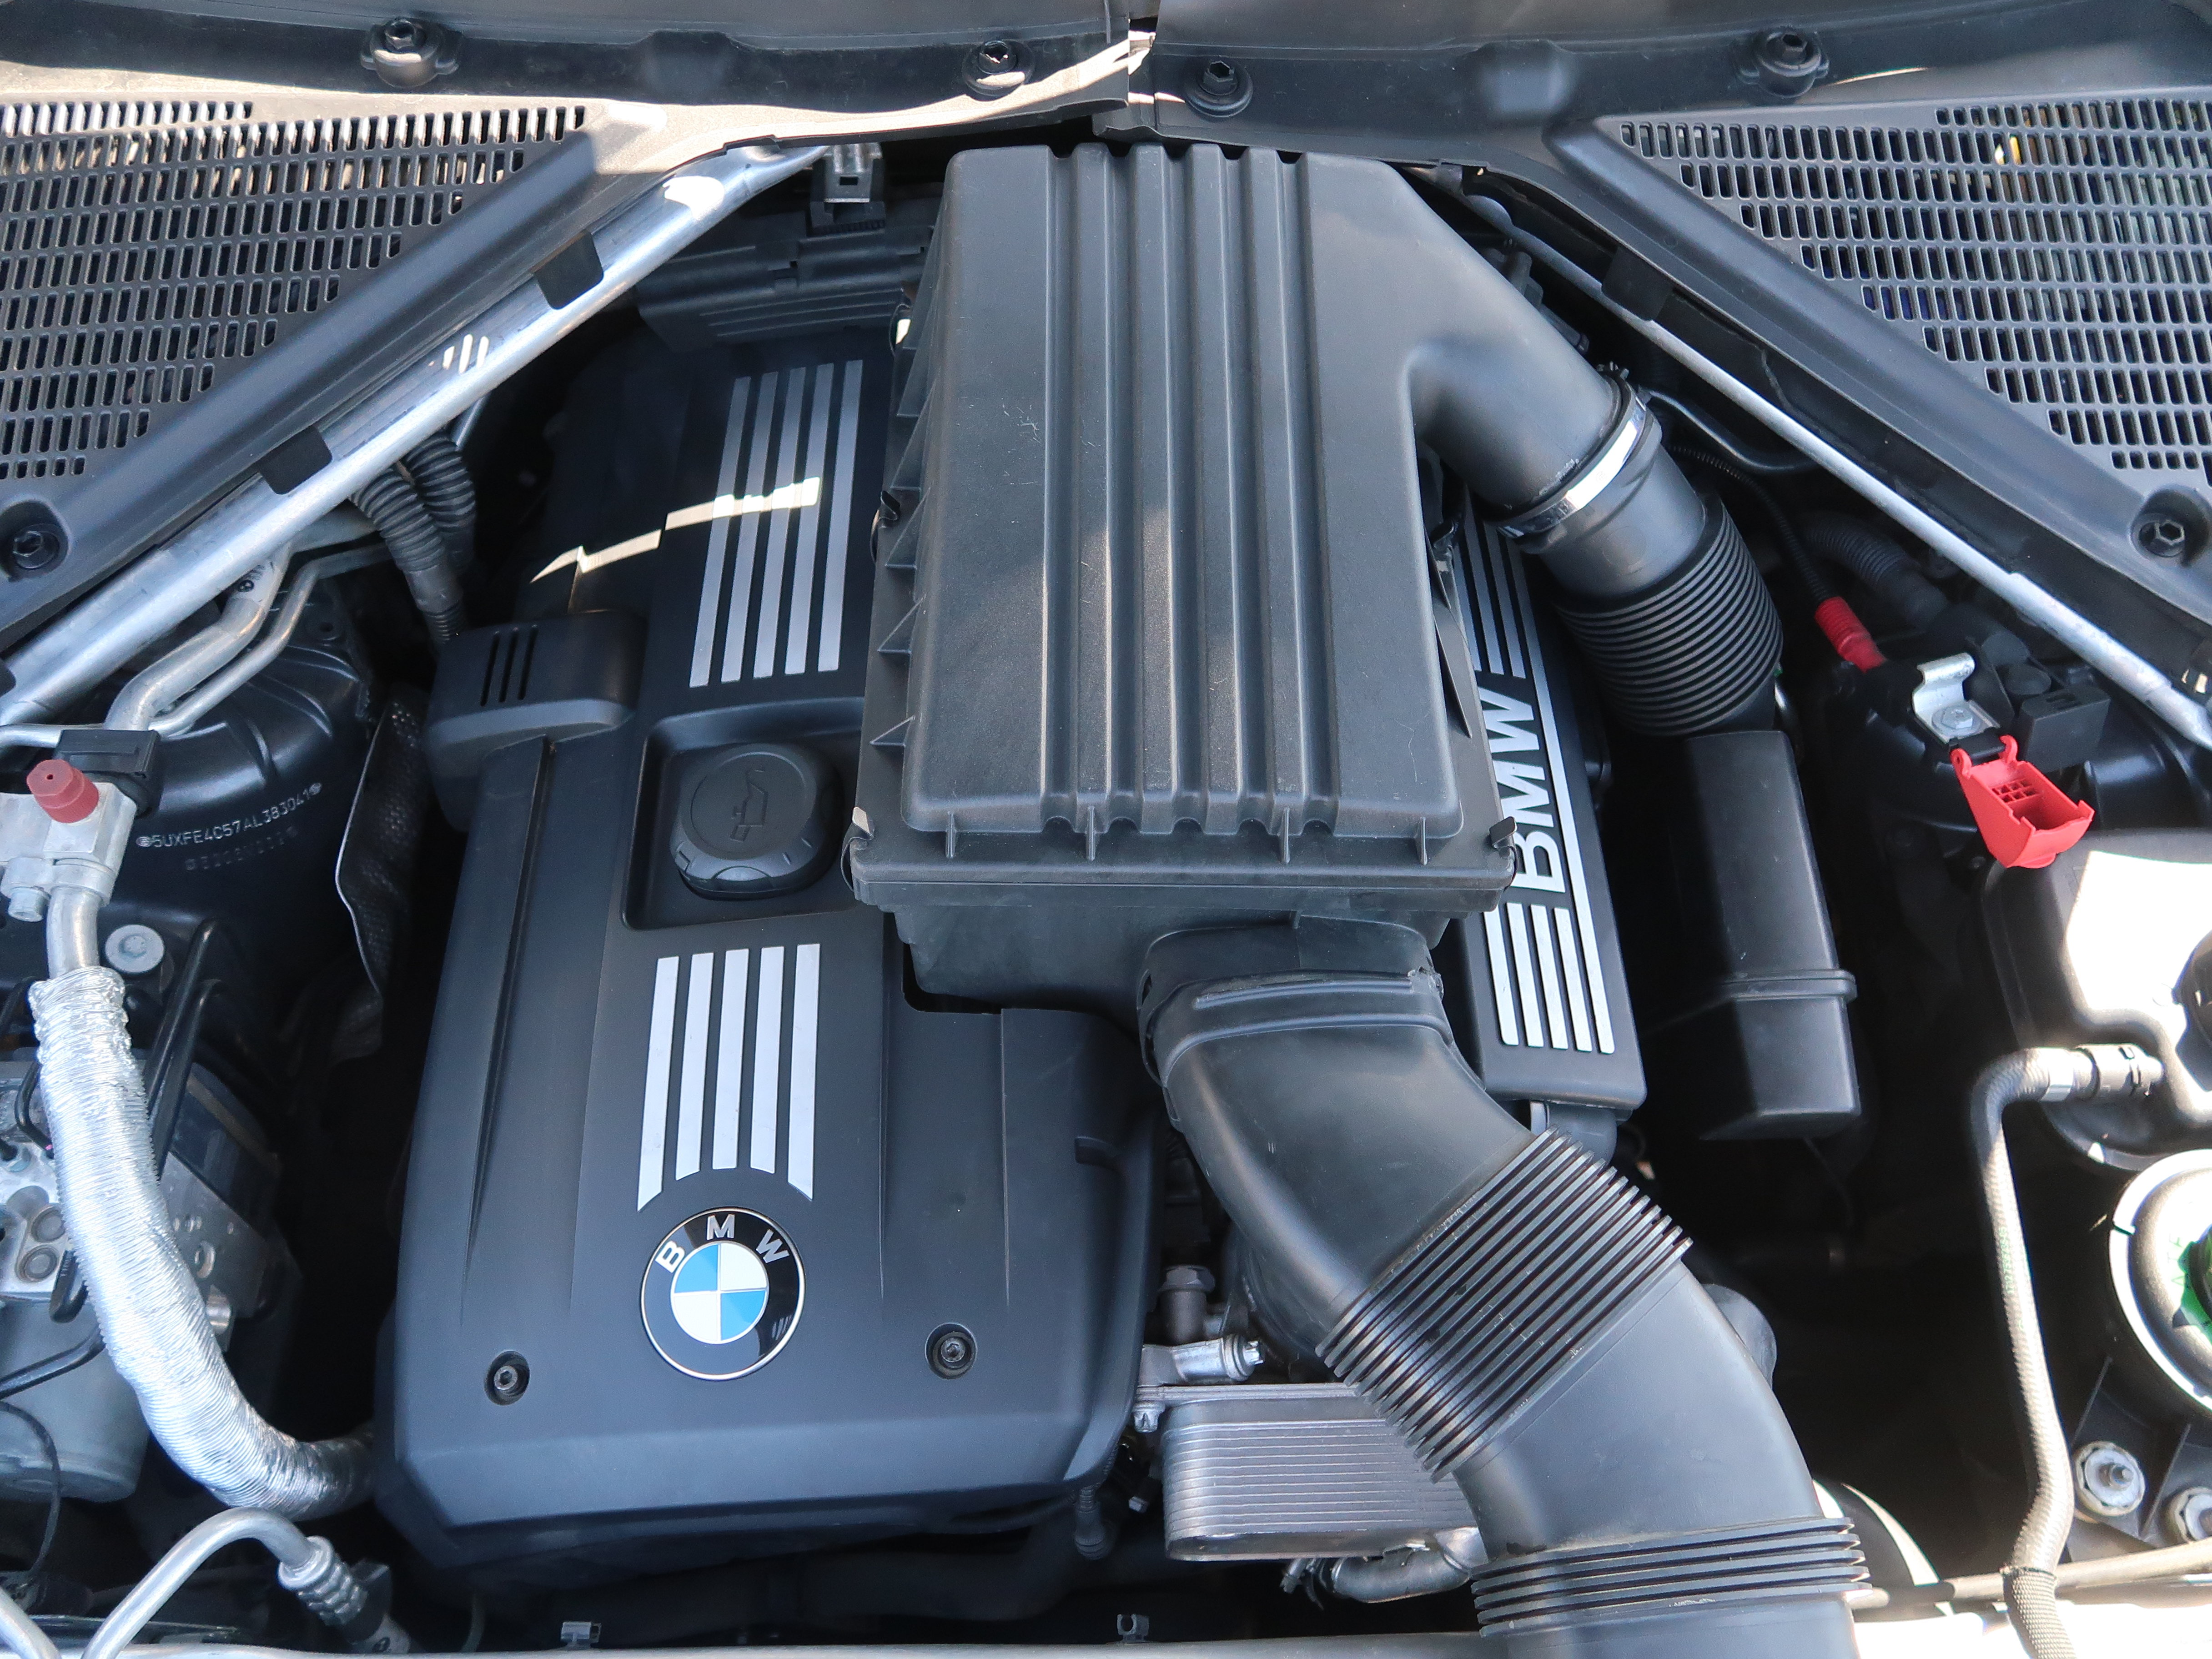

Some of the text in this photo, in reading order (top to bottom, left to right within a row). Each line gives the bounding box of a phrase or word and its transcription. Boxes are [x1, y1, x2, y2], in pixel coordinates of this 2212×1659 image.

[152, 789, 312, 848] 5UXFE4C57AL383041
[1478, 687, 1566, 893] BMW
[655, 1213, 790, 1273] BMW
